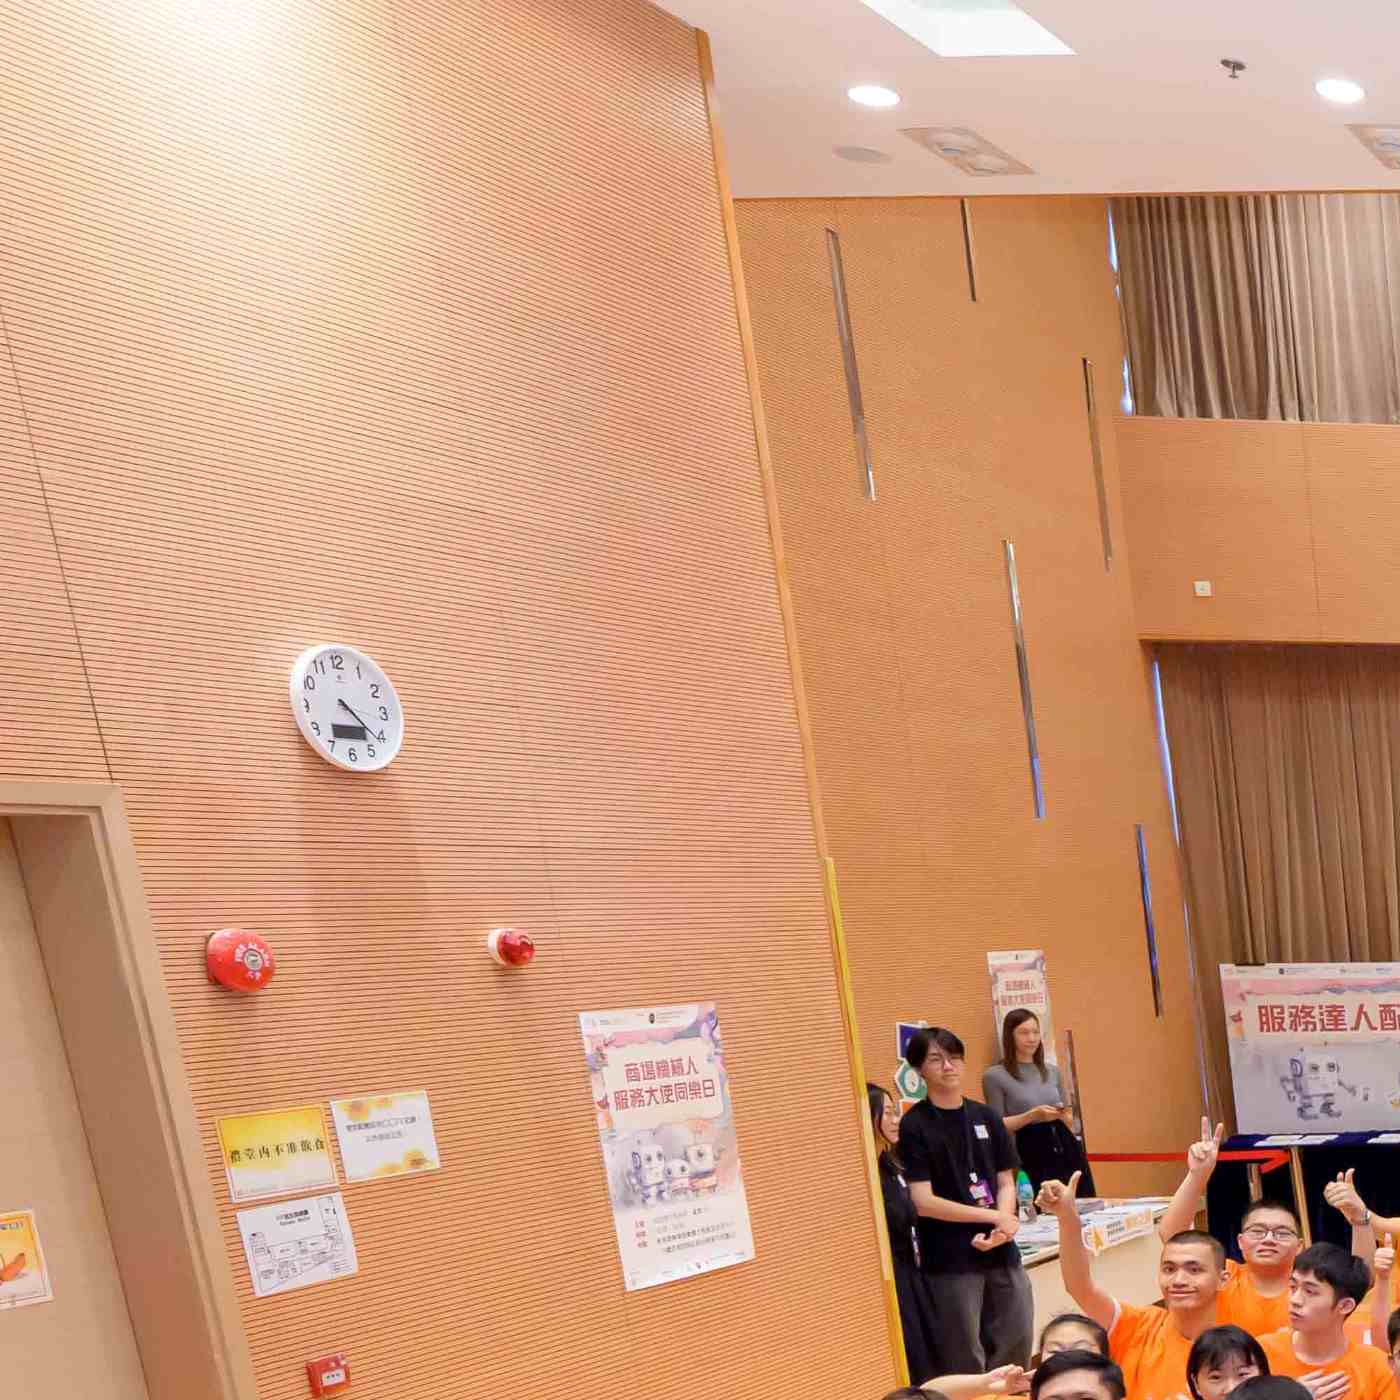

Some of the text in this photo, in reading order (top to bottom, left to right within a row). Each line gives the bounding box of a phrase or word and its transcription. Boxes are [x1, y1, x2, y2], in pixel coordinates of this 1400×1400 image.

[313, 660, 326, 675] 11
[329, 655, 345, 670] 12
[369, 684, 381, 698] 2
[378, 706, 389, 721] 3
[327, 740, 336, 753] 7
[367, 744, 377, 757] 5
[348, 748, 358, 762] 6
[614, 1079, 715, 1111] 服務大使同樂日
